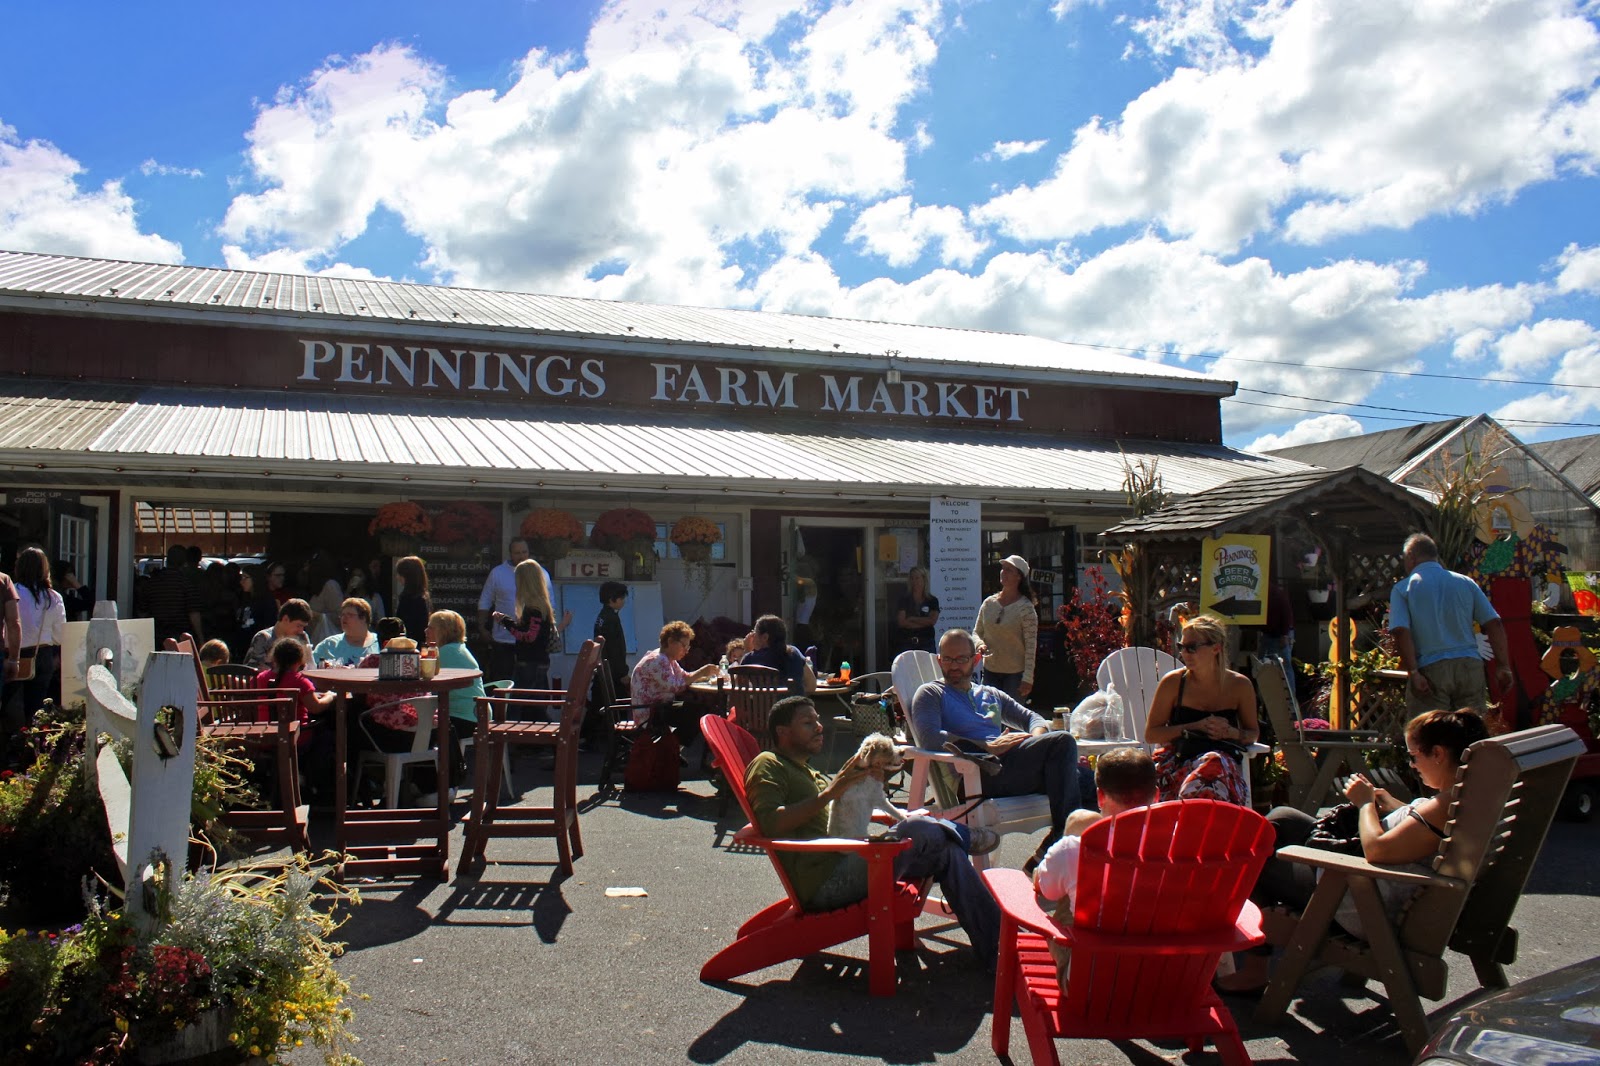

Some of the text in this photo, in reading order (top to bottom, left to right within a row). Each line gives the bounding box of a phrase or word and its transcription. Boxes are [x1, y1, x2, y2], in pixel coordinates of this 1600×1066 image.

[297, 339, 1029, 421] PENNINGS FARM MARKET
[1214, 547, 1257, 566] PENNINGS
[570, 563, 609, 577] ICE
[1033, 570, 1055, 583] OPEN
[1224, 567, 1250, 576] BEER
[1218, 575, 1254, 586] GARDEN
